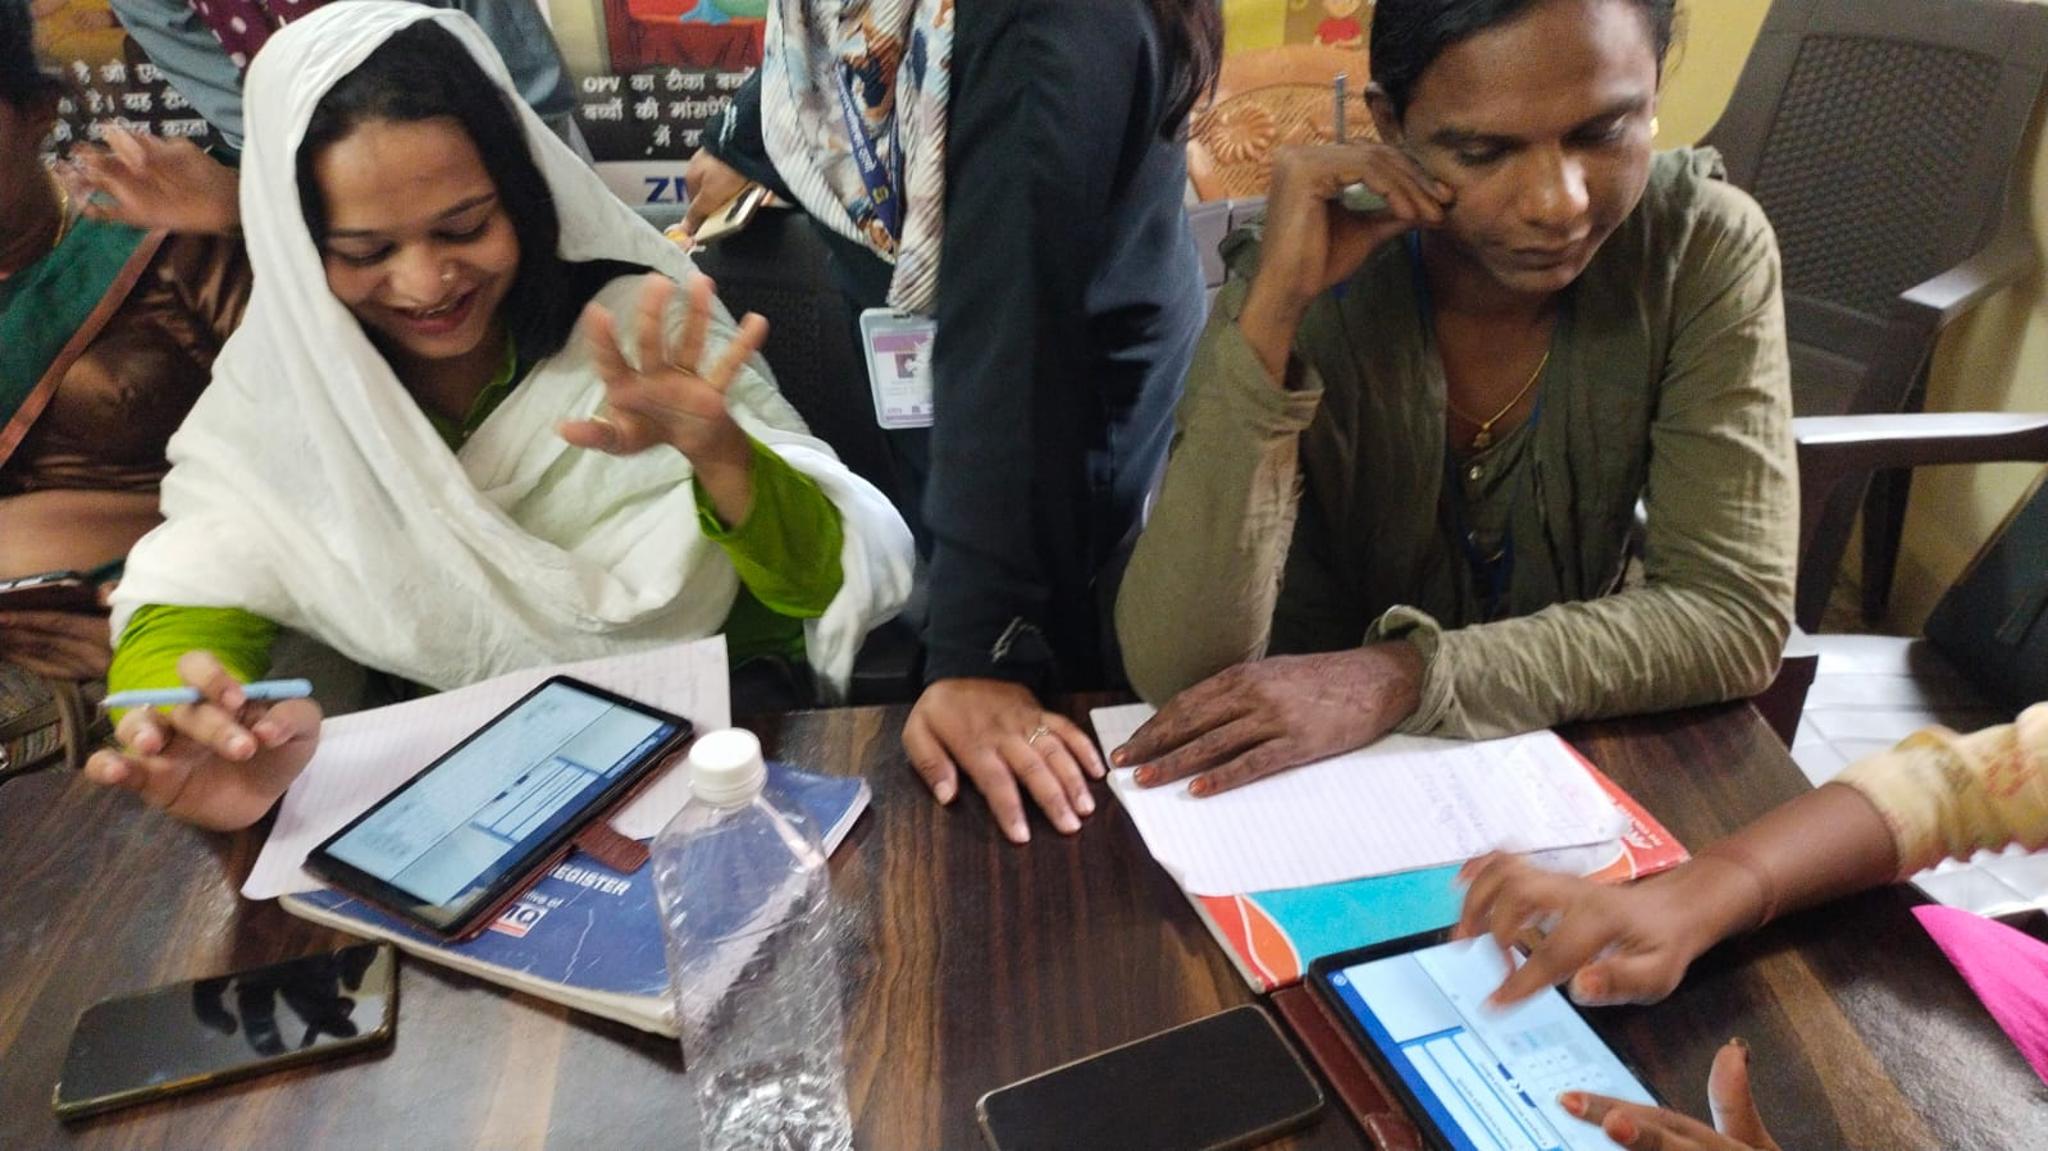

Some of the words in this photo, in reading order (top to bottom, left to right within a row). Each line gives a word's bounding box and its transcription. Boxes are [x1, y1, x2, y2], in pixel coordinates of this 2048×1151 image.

[582, 76, 620, 93] OPV
[629, 74, 654, 91] का
[665, 68, 705, 92] टीका
[583, 97, 623, 121] बच्चों
[634, 96, 659, 120] की
[653, 124, 671, 147] में
